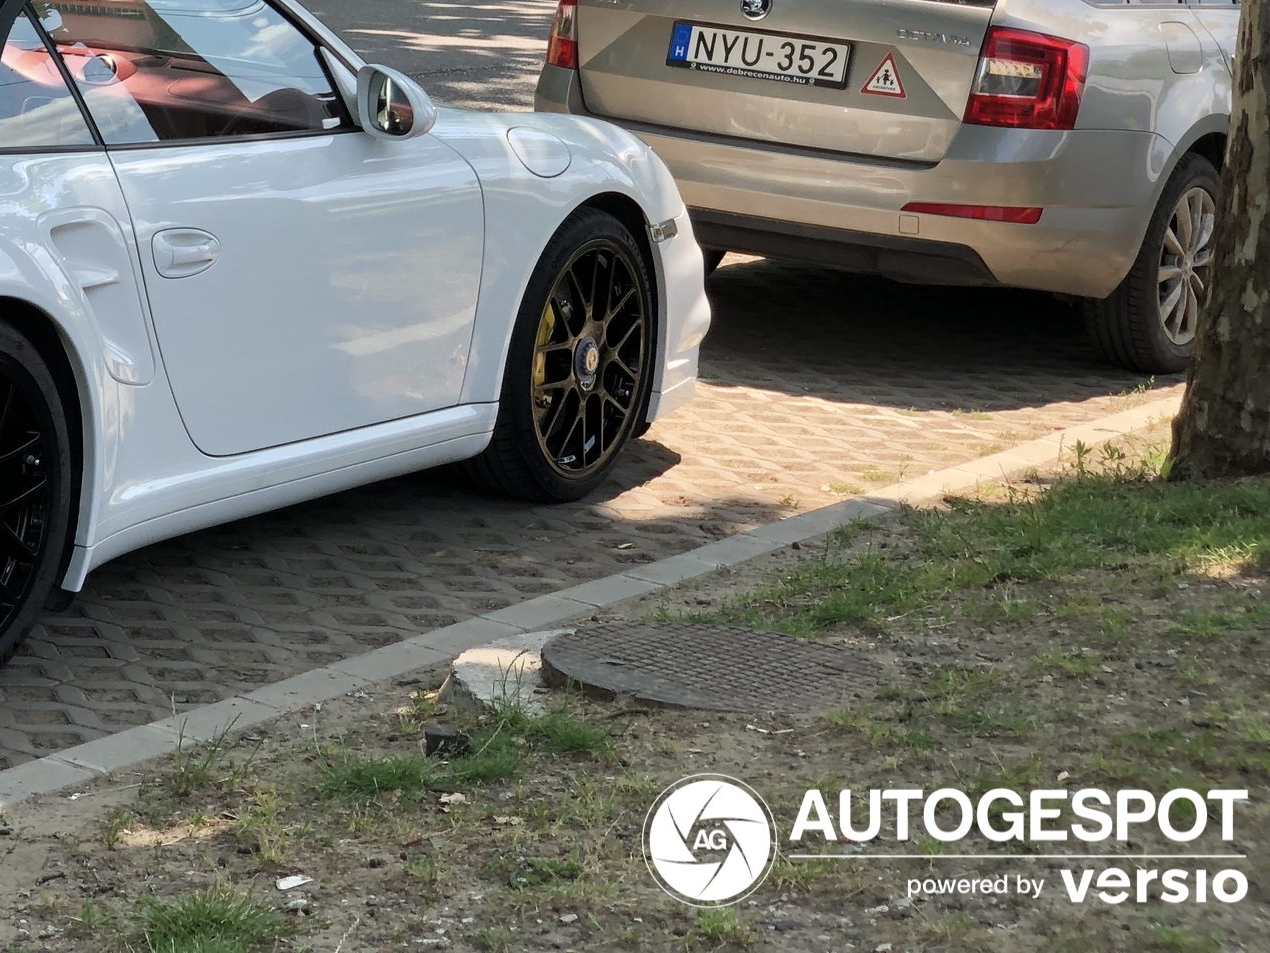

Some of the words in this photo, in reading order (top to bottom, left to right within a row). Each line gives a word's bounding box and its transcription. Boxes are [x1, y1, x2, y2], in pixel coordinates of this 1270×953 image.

[675, 46, 685, 57] H
[693, 31, 838, 78] NYU-352
[699, 64, 806, 84] www.debrecenauto.hu
